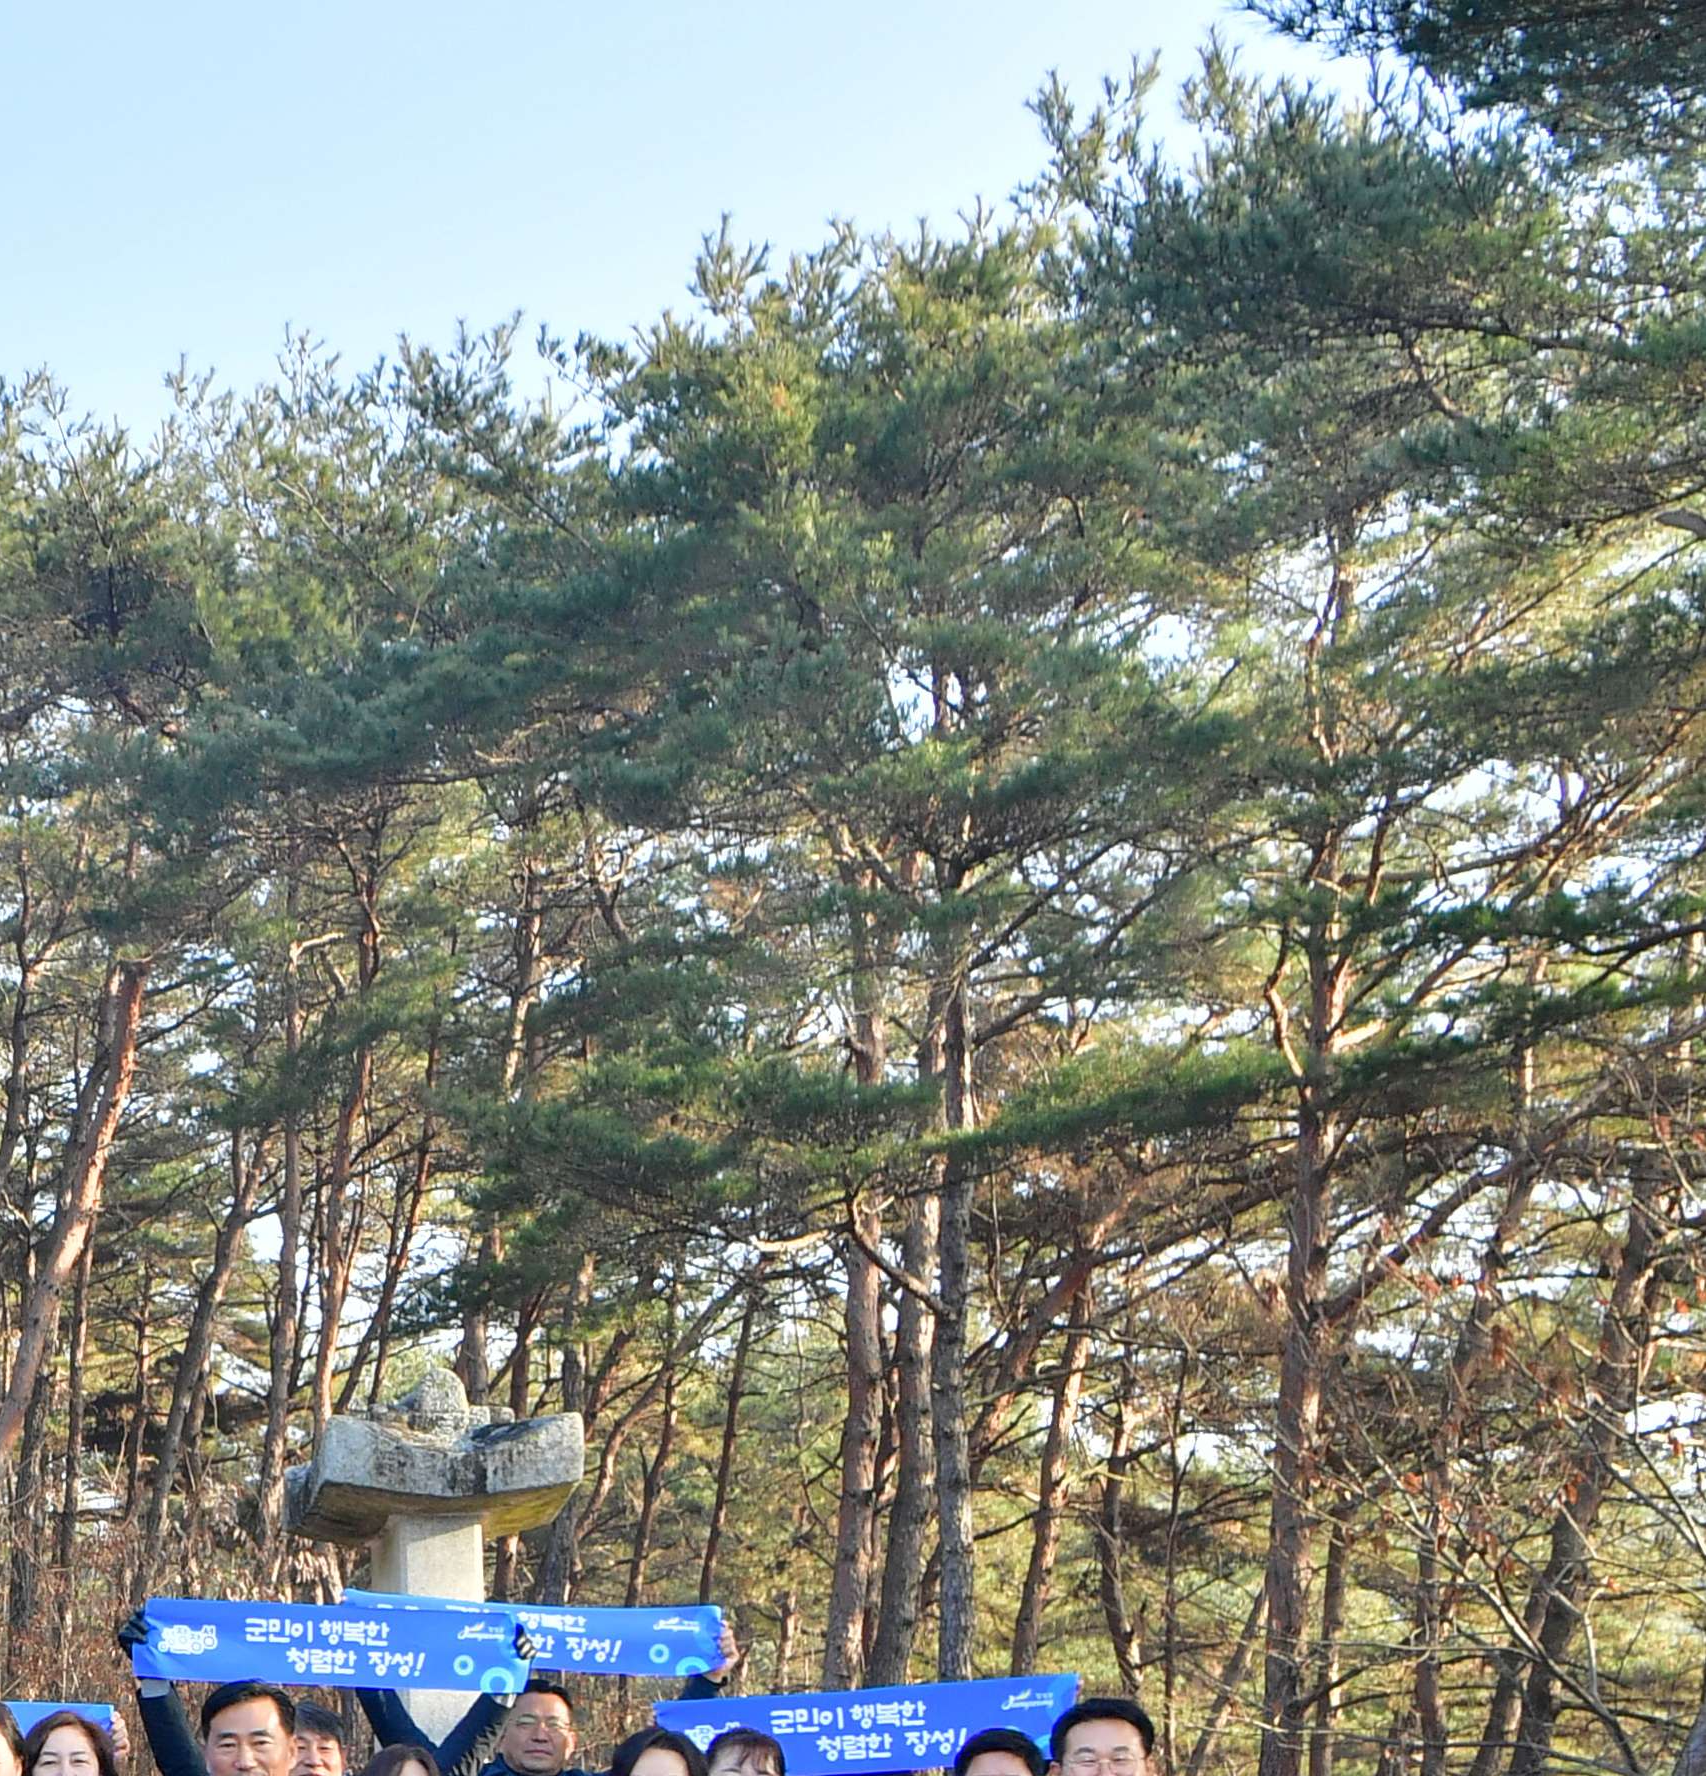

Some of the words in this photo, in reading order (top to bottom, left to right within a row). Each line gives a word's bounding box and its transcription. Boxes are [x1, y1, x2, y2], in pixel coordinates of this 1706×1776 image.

[245, 1617, 315, 1643] 군민이
[321, 1619, 390, 1647] 행복한
[285, 1647, 356, 1675] 청렴한
[368, 1652, 426, 1677] 장성!
[565, 1638, 623, 1663] 장성!
[770, 1707, 843, 1735] 군민이
[850, 1701, 926, 1728] 행복한
[816, 1732, 893, 1761] 청렴한
[904, 1728, 967, 1756] 장성!
